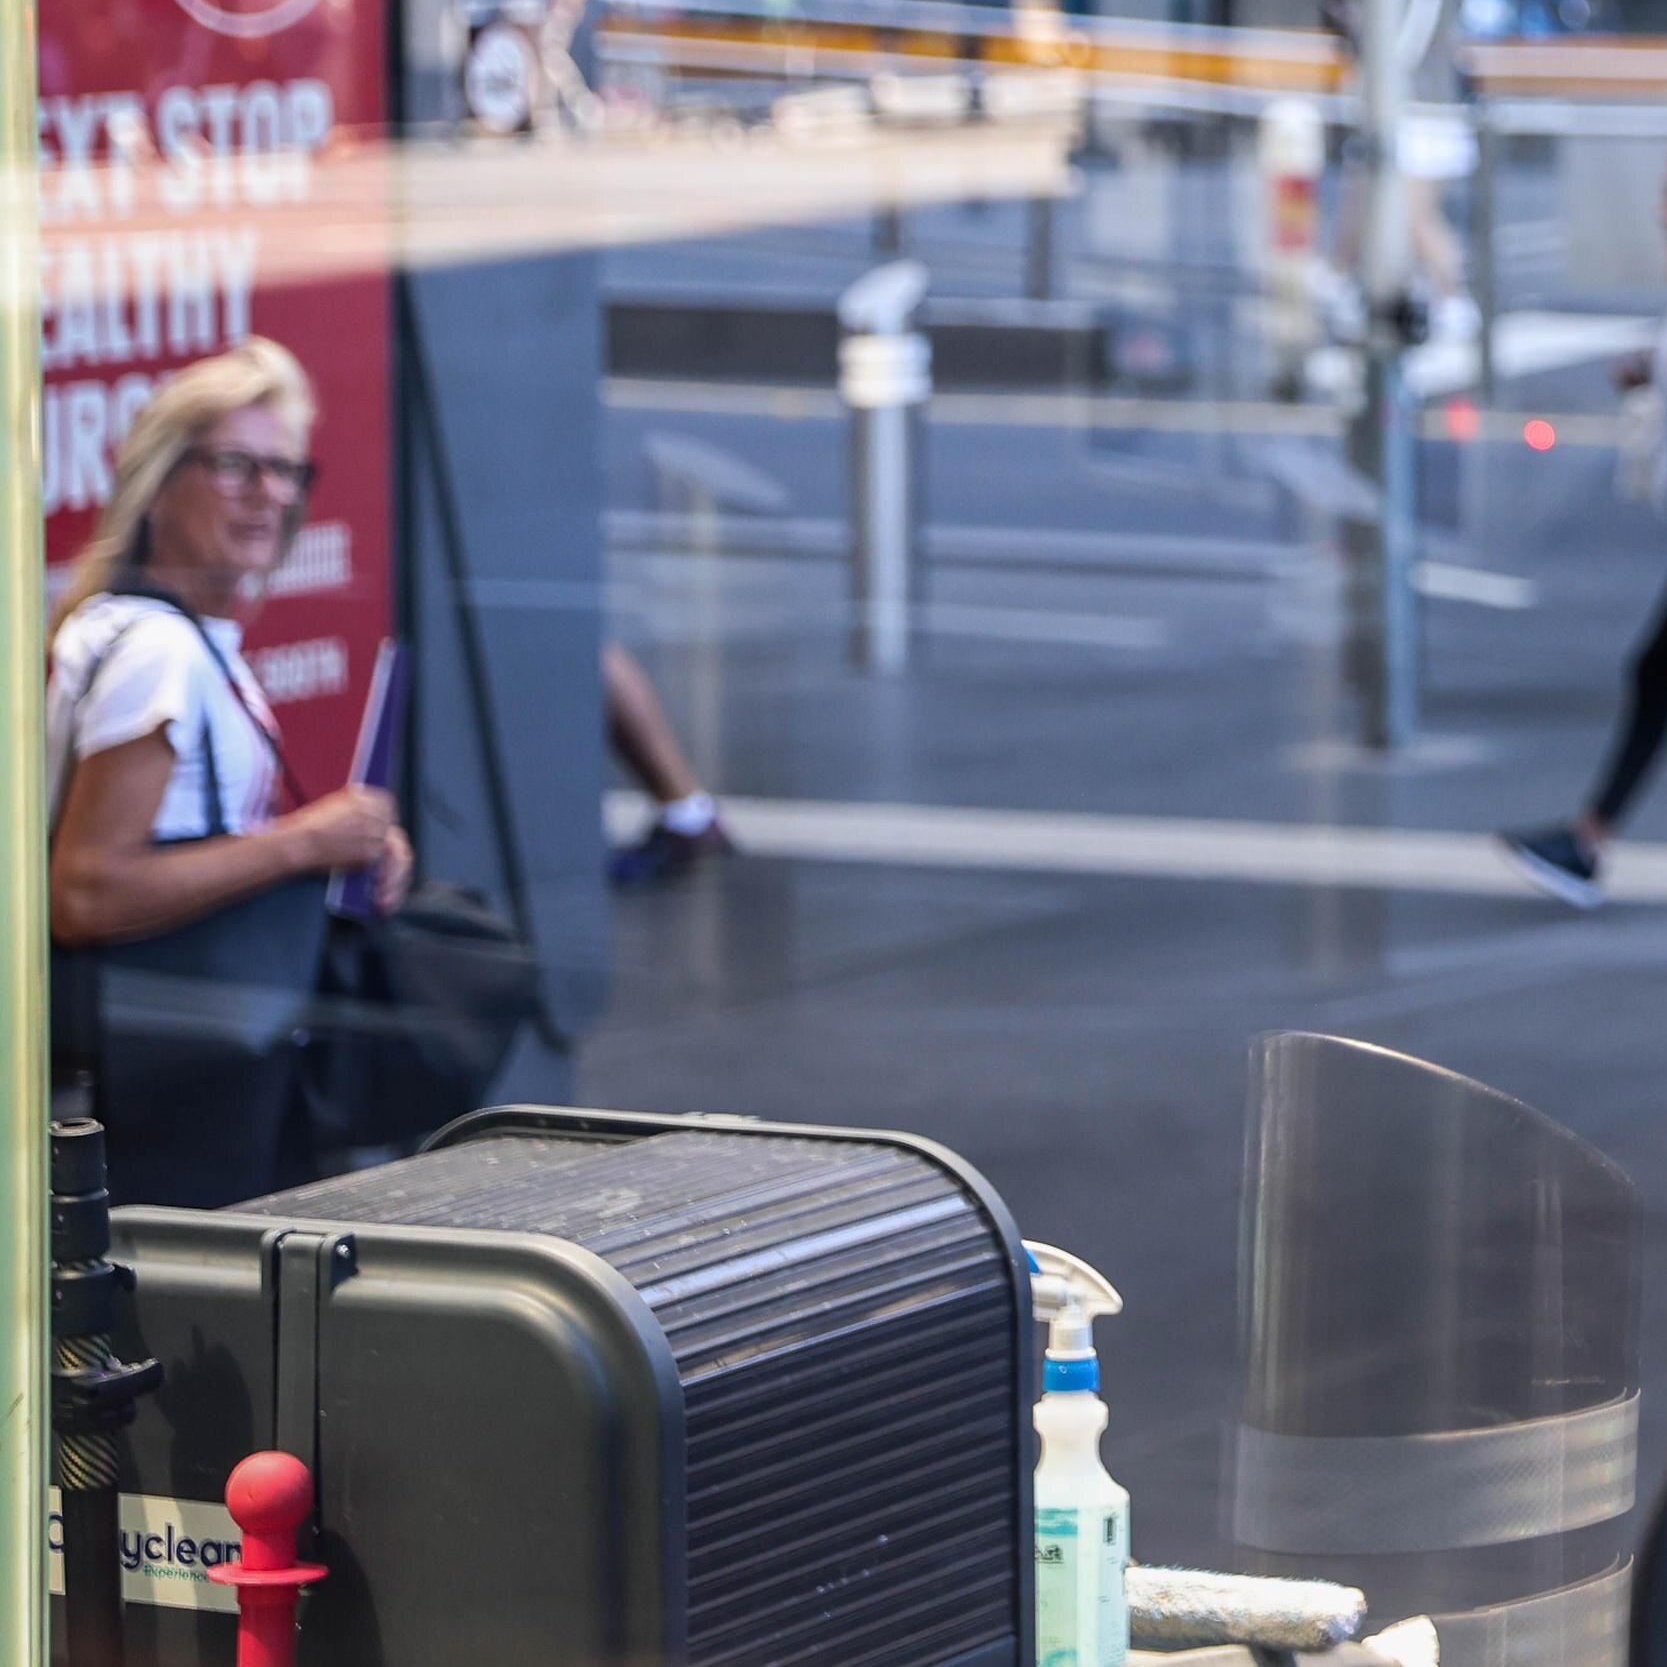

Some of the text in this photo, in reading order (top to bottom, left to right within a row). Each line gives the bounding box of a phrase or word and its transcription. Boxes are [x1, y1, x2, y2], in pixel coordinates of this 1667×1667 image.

[38, 78, 333, 222] EXT STOP
[40, 225, 258, 370] EALTHY
